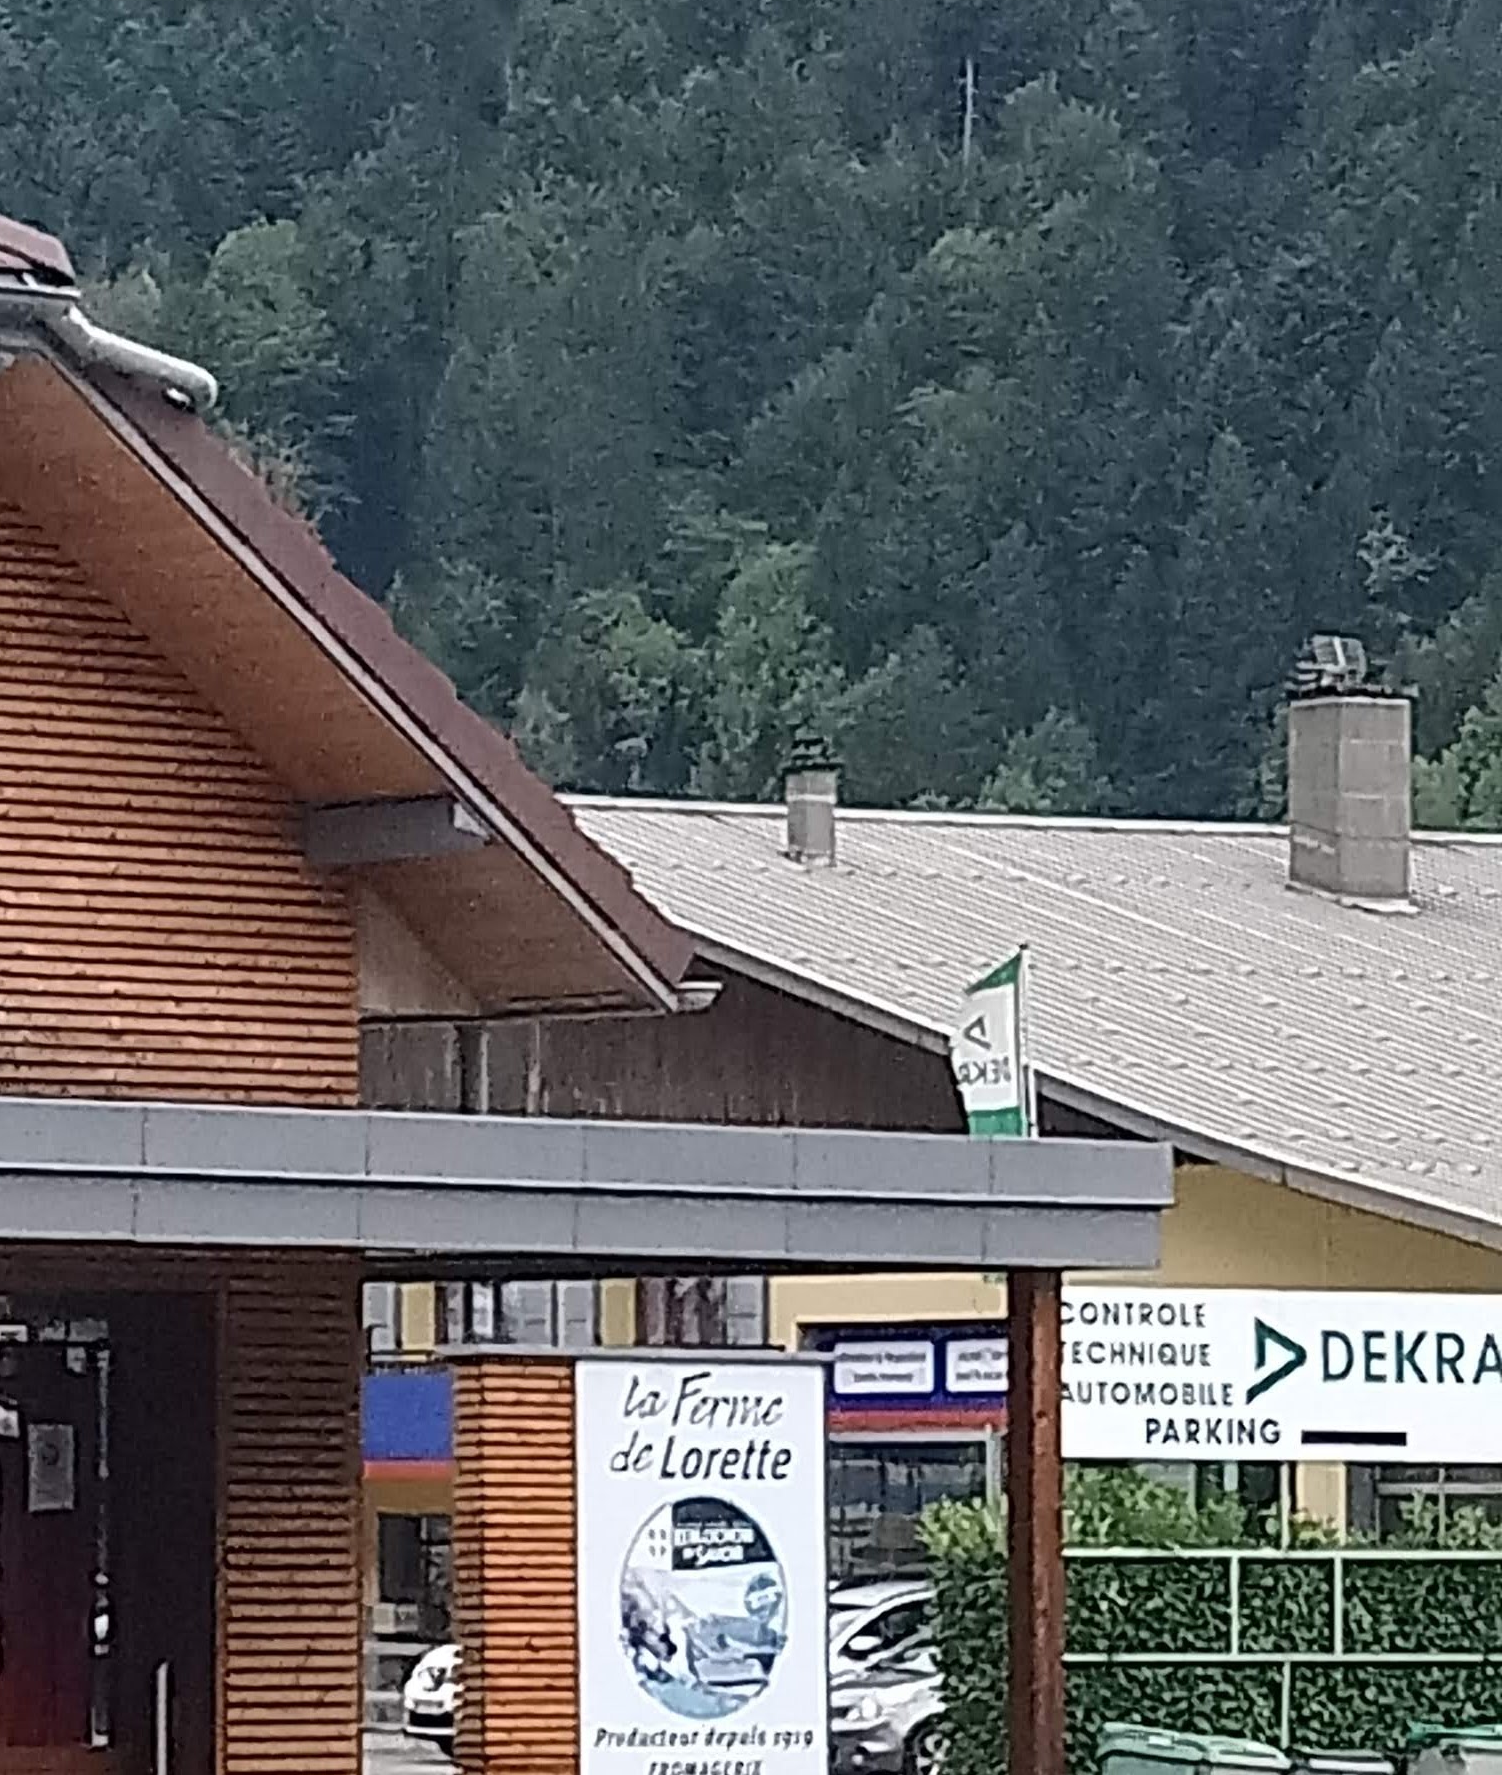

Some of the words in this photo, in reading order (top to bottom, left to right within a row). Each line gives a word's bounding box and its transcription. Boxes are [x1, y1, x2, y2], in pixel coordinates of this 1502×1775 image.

[1061, 1301, 1206, 1328] CONTROLE
[1320, 1329, 1502, 1385] DEKRA
[671, 1370, 784, 1428] Ferme
[1061, 1382, 1234, 1407] AUTOMOBILE
[1145, 1417, 1281, 1446] PARKING
[610, 1430, 655, 1473] de
[659, 1435, 793, 1481] Lorette
